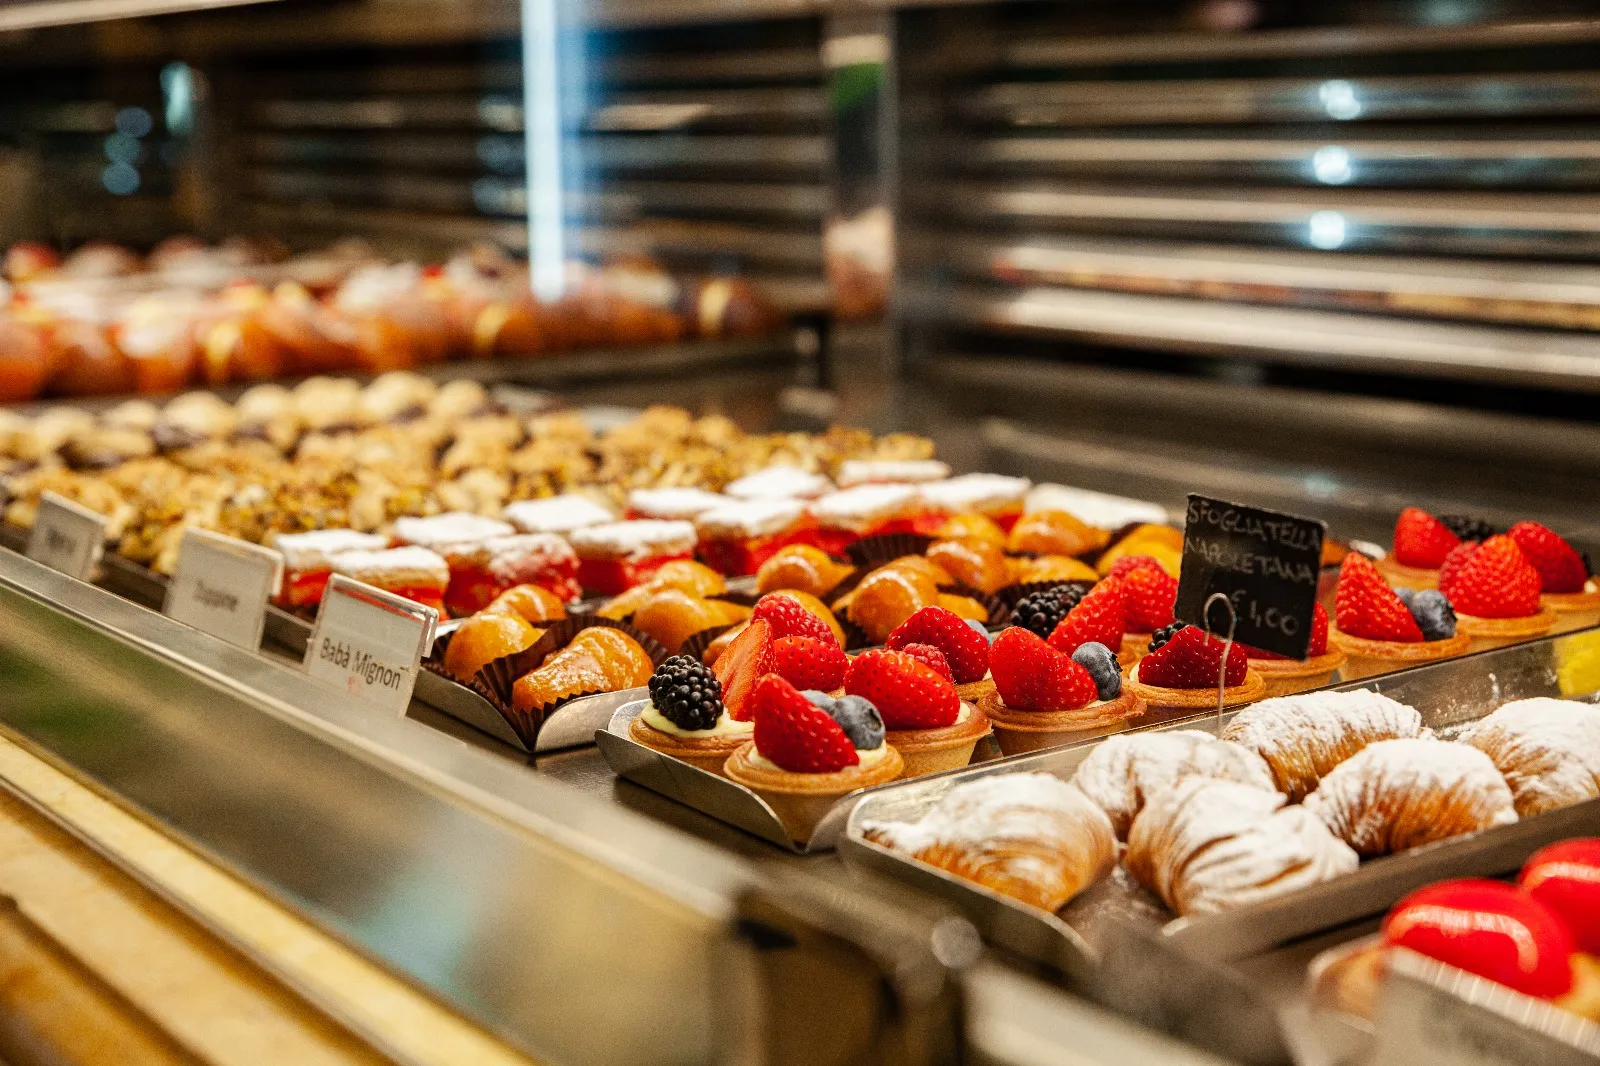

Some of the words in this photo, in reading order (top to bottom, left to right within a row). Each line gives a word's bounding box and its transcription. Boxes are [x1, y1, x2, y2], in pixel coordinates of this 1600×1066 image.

[1188, 499, 1321, 553] SFOGLIATELLA
[320, 637, 350, 669] Babà
[352, 651, 401, 690] Mignon
